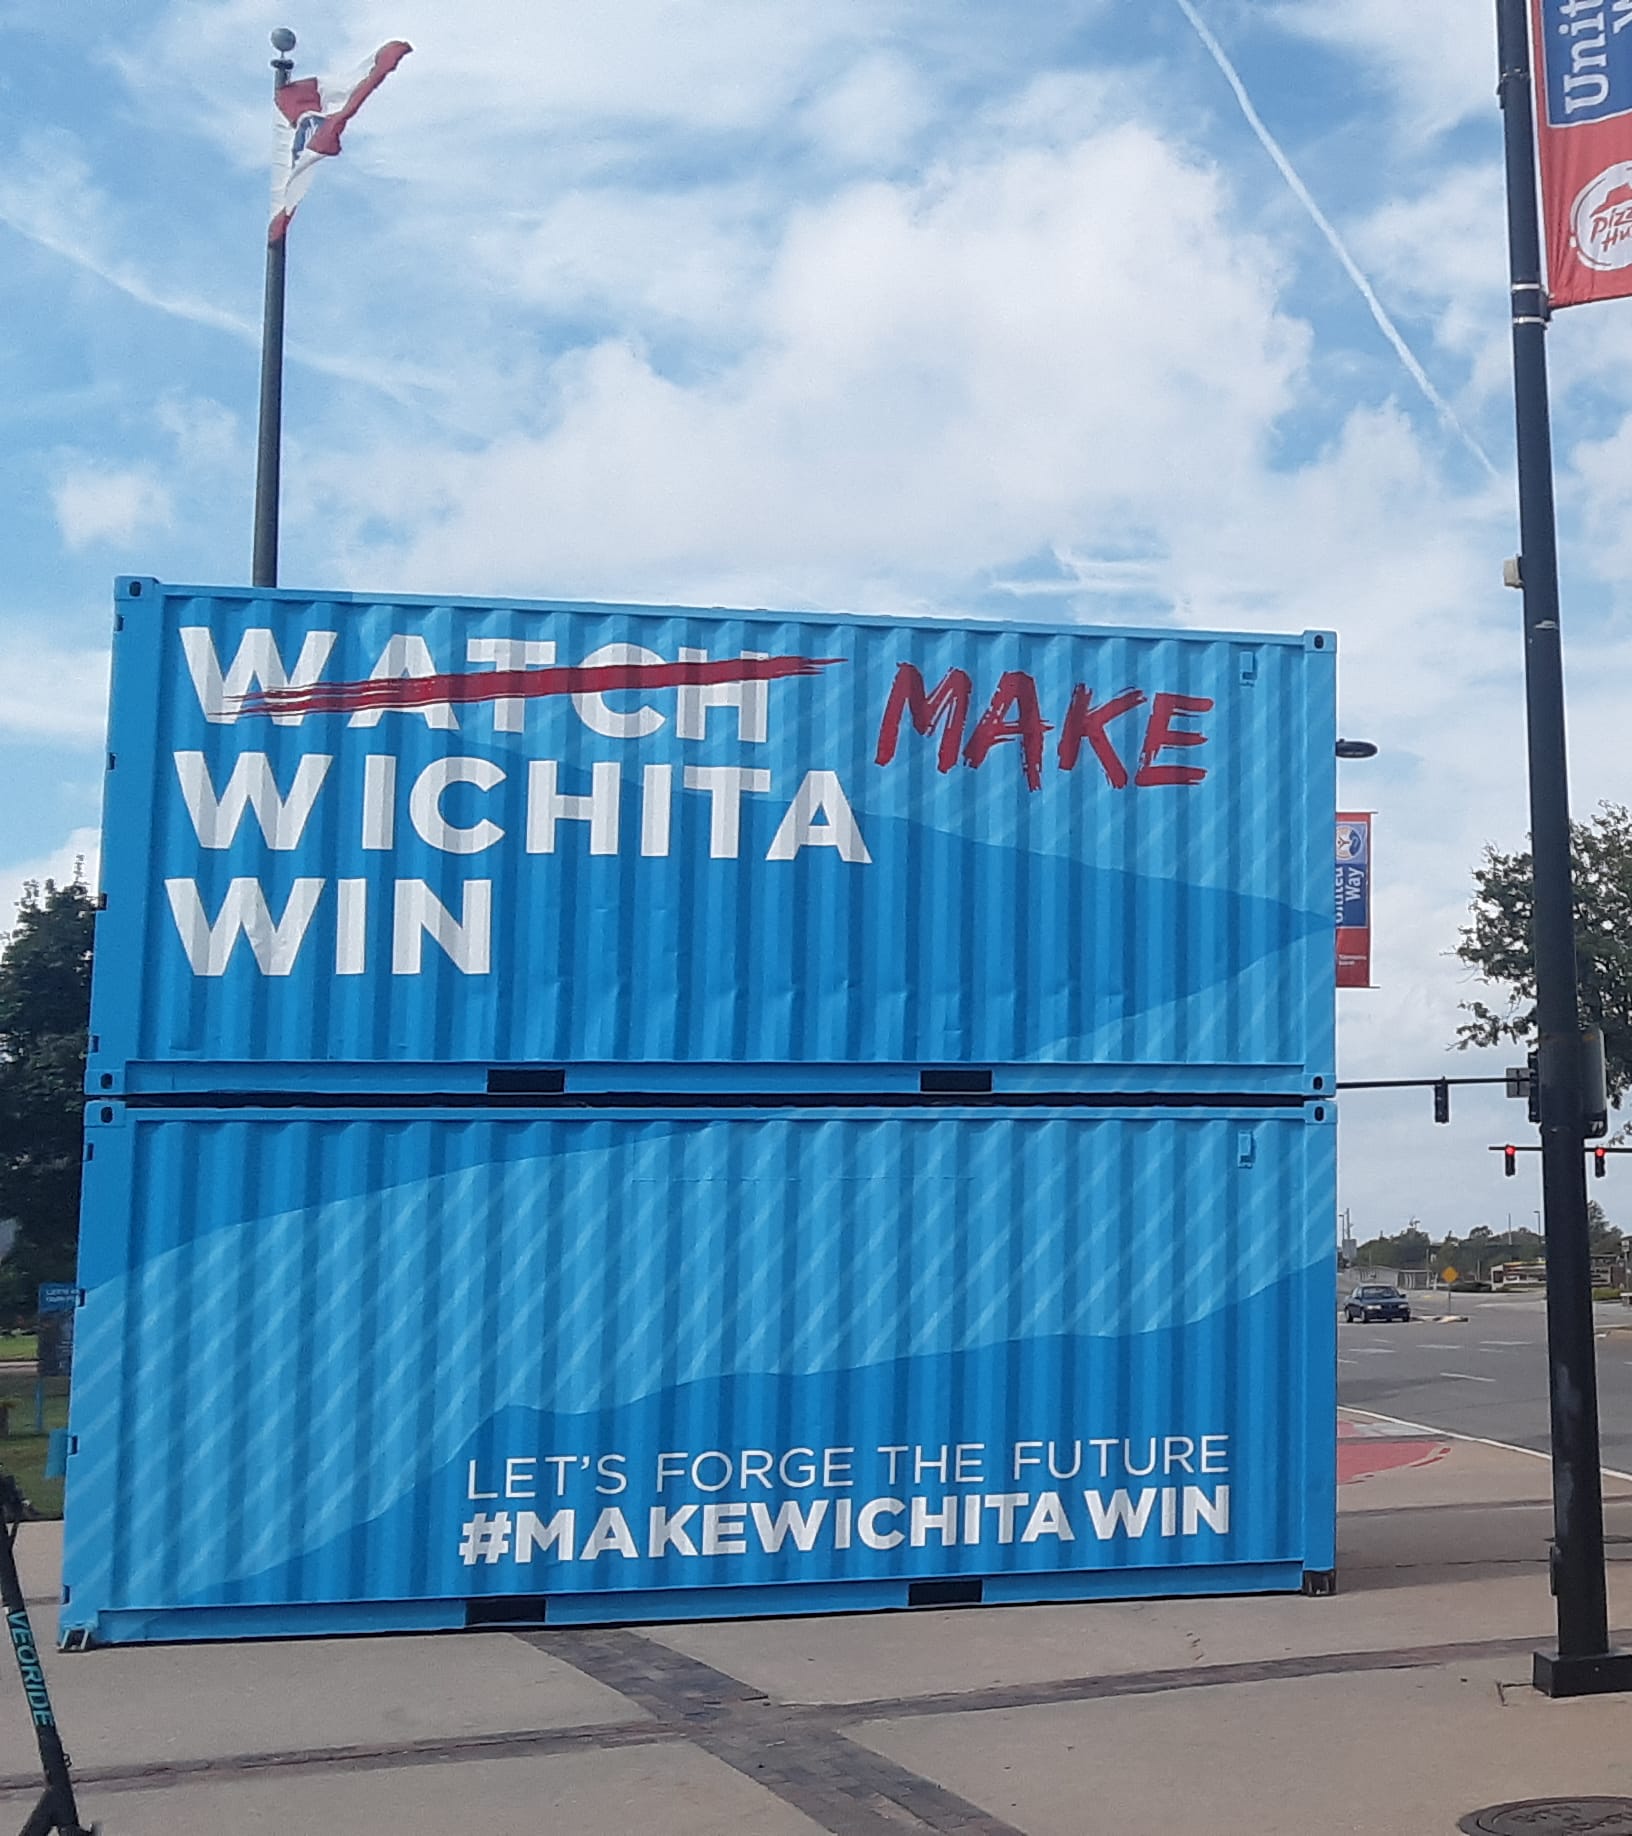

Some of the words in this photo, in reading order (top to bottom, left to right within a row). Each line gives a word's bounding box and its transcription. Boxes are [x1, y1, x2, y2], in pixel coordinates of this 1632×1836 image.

[179, 626, 769, 744] WATCH
[873, 661, 1215, 793] MAKE
[172, 750, 873, 864] WICHITA
[165, 876, 492, 977] WIN
[1344, 866, 1365, 902] Way
[467, 1454, 628, 1500] LET'S
[655, 1447, 854, 1494] FORGE
[876, 1442, 986, 1486] THE
[1013, 1434, 1230, 1481] FUTURE
[457, 1484, 1230, 1566] #MAKEWICHITAWIN
[7, 1611, 55, 1727] VEORIDE
